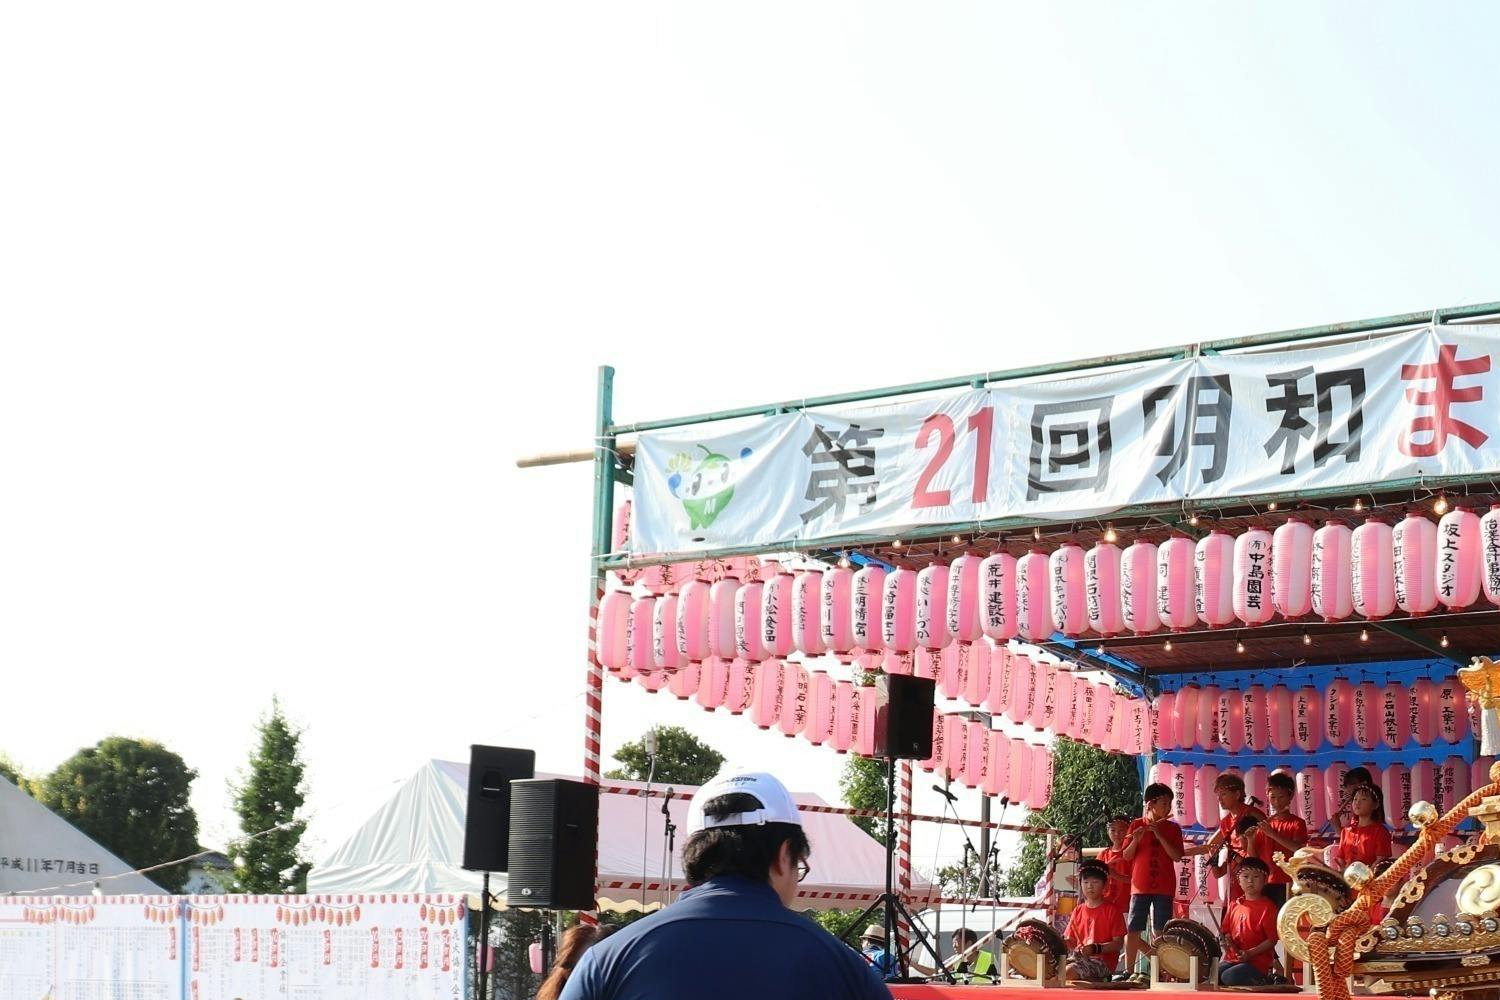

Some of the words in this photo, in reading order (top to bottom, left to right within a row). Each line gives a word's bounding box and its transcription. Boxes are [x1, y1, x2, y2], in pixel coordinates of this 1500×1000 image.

[1440, 522, 1461, 597] 坂上スタジオ
[0, 857, 98, 875] 平成11年7月吉日
